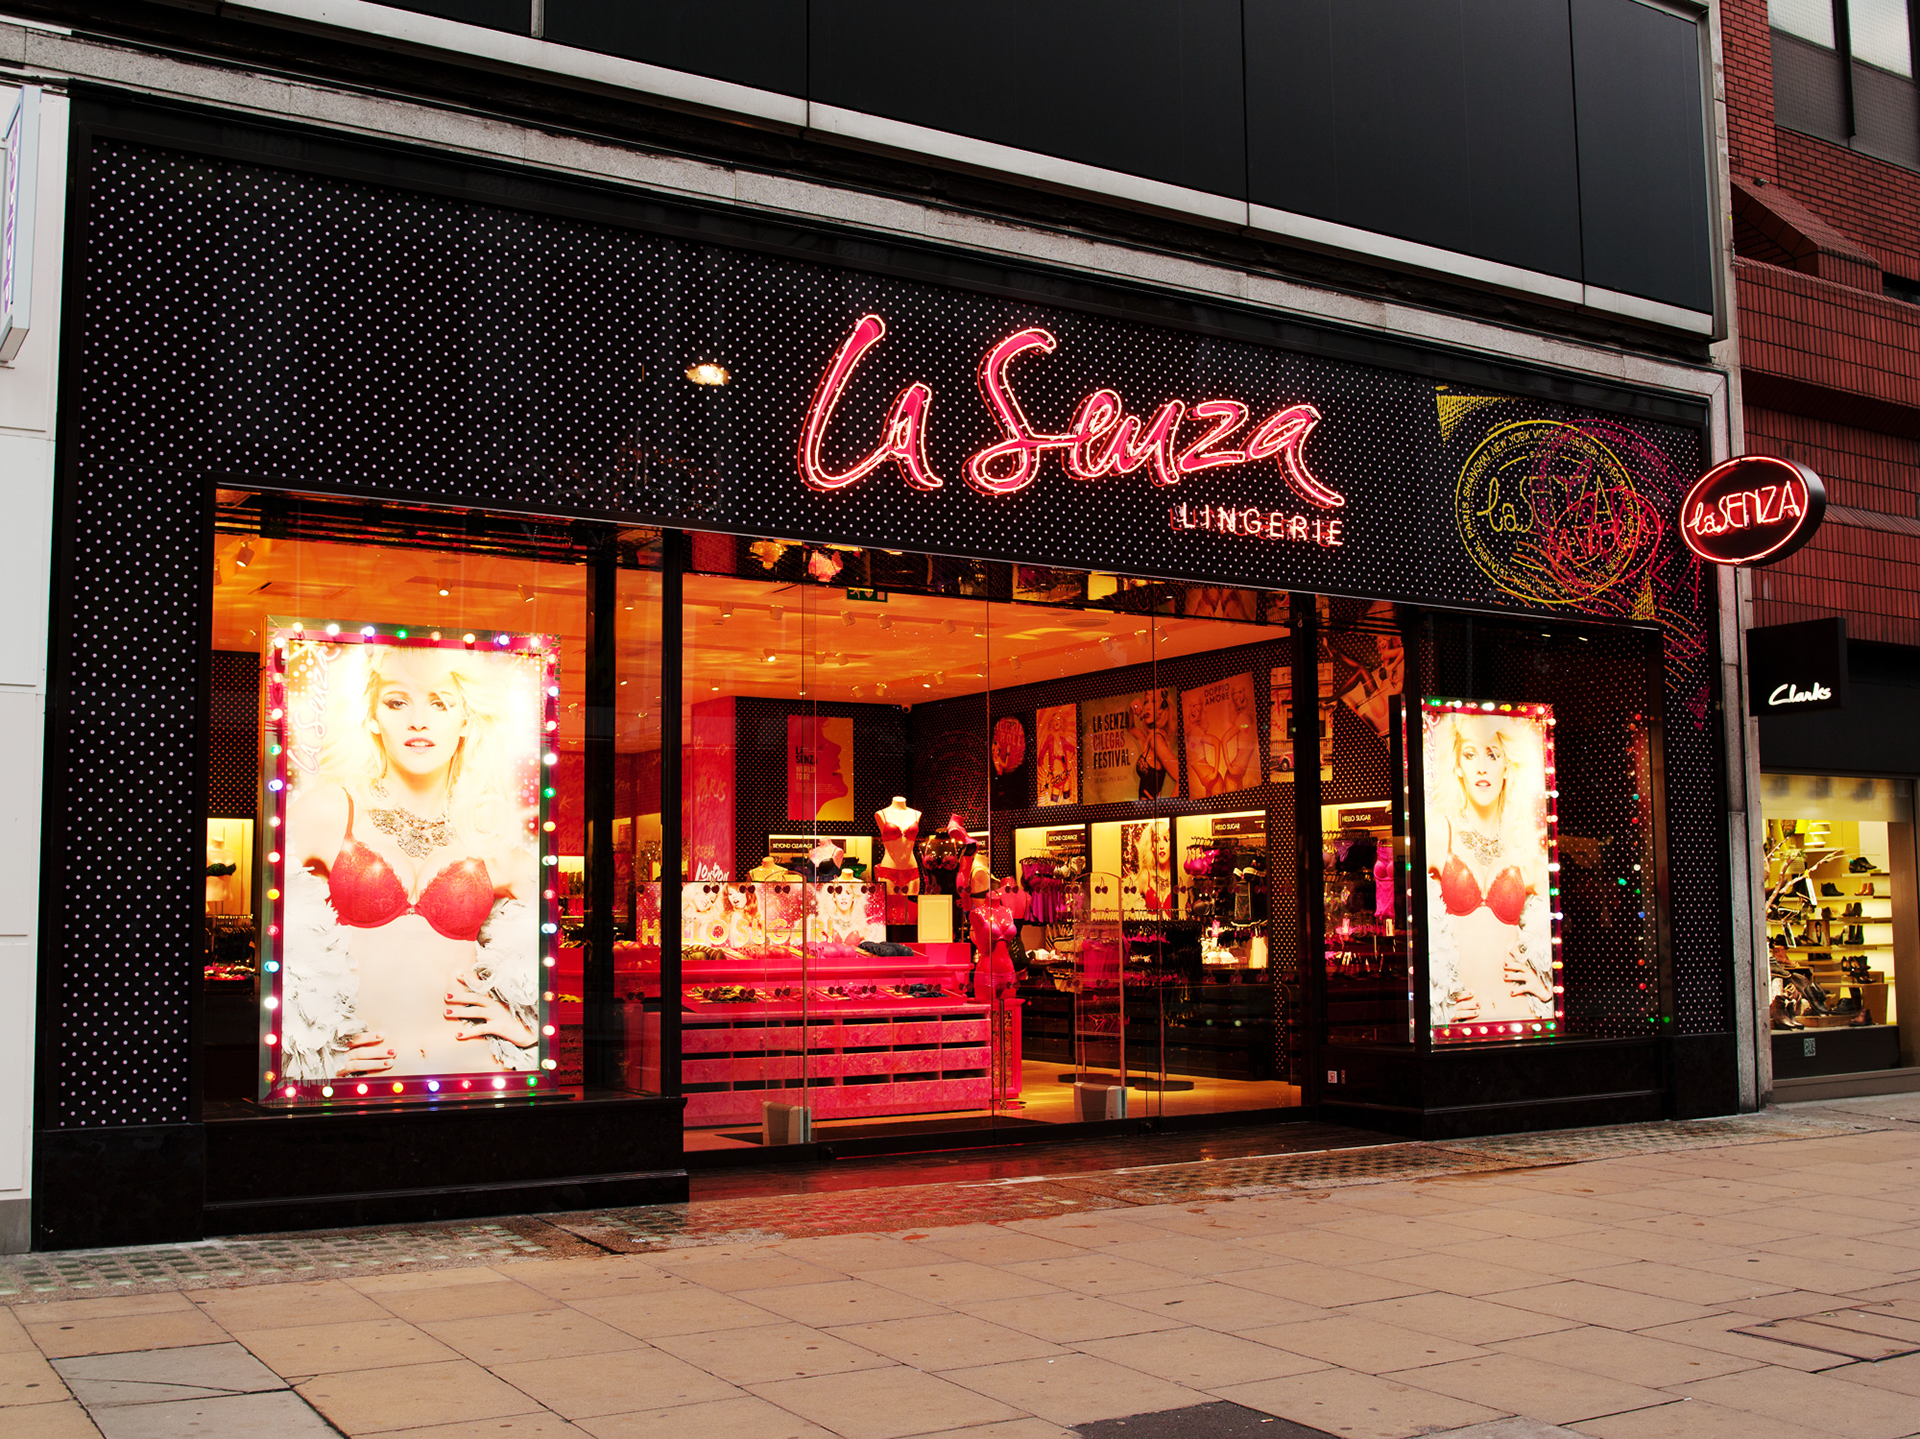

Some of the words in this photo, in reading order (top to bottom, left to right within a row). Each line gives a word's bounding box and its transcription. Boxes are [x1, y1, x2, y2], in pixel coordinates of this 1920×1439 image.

[962, 326, 1345, 508] Senza
[1463, 449, 1491, 498] SHANGHAI
[1182, 501, 1344, 546] LINGERIE
[1768, 681, 1832, 706] Clarks
[1093, 714, 1103, 733] LA
[1104, 711, 1131, 732] SENZA
[1093, 748, 1131, 770] FESTIVAL
